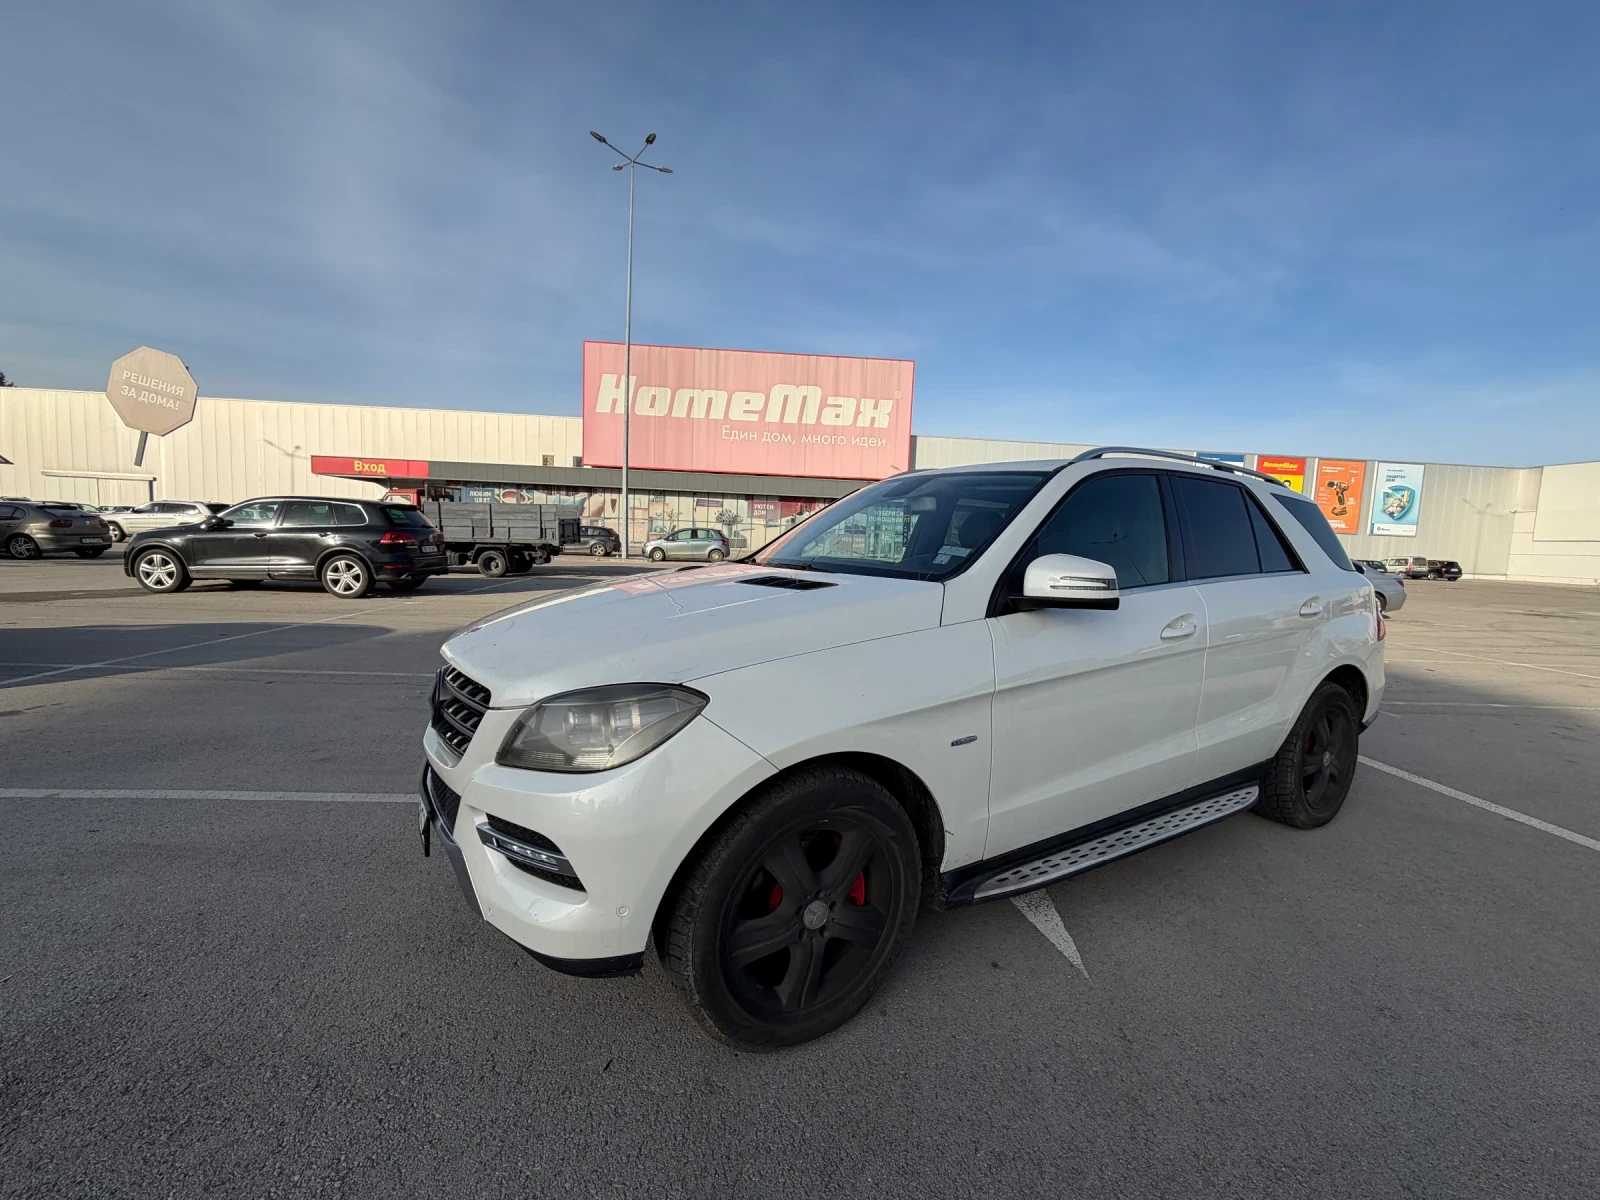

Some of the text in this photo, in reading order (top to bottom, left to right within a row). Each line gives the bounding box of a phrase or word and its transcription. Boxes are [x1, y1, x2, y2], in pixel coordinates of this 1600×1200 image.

[122, 370, 185, 397] РЕШЕНИЯ
[120, 385, 180, 411] ЗА ДОМА!
[595, 373, 893, 429] HomeMax
[722, 425, 890, 448] Един дом, много идеи.
[354, 460, 386, 474] Вход
